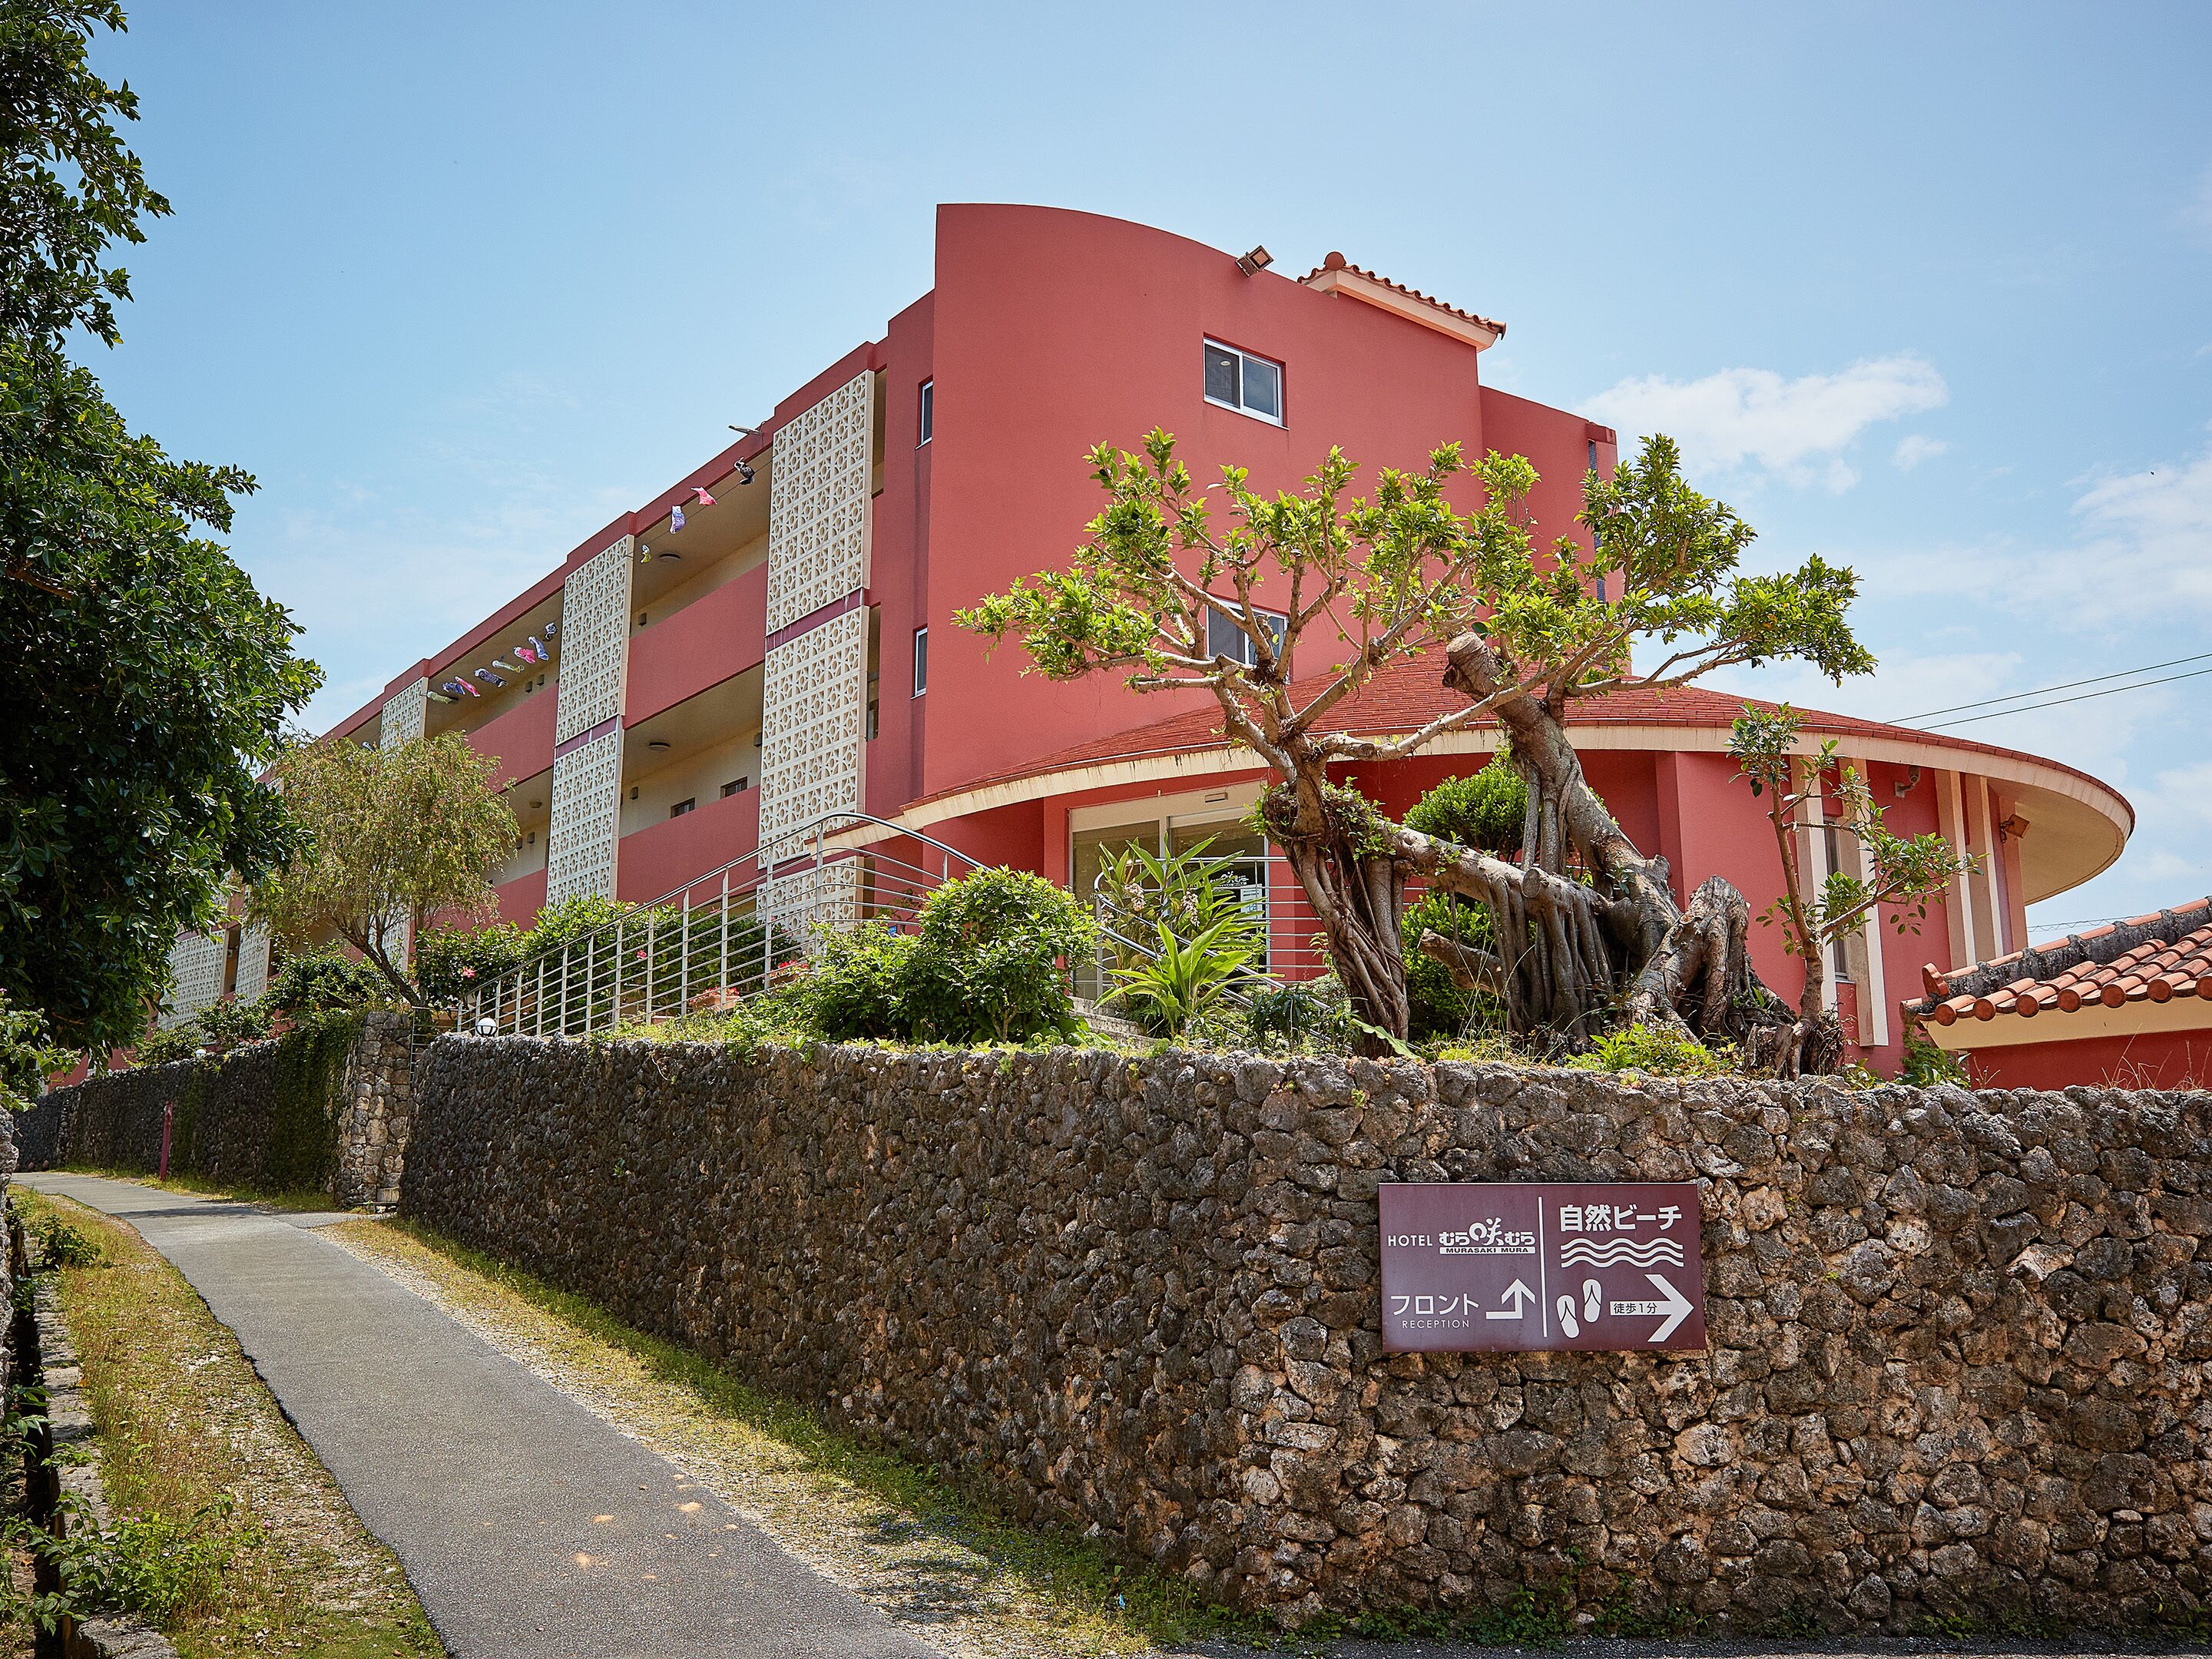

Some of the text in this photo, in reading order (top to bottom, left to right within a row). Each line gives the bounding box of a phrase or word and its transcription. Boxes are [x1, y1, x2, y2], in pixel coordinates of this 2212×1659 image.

[1559, 1204, 1682, 1232] 自然ビーチ
[1387, 1217, 1536, 1247] HOTEL むら咲むら
[1390, 1293, 1480, 1316] フロント
[1613, 1303, 1657, 1314] 徒歩1分
[1402, 1320, 1470, 1329] RECEPTION
